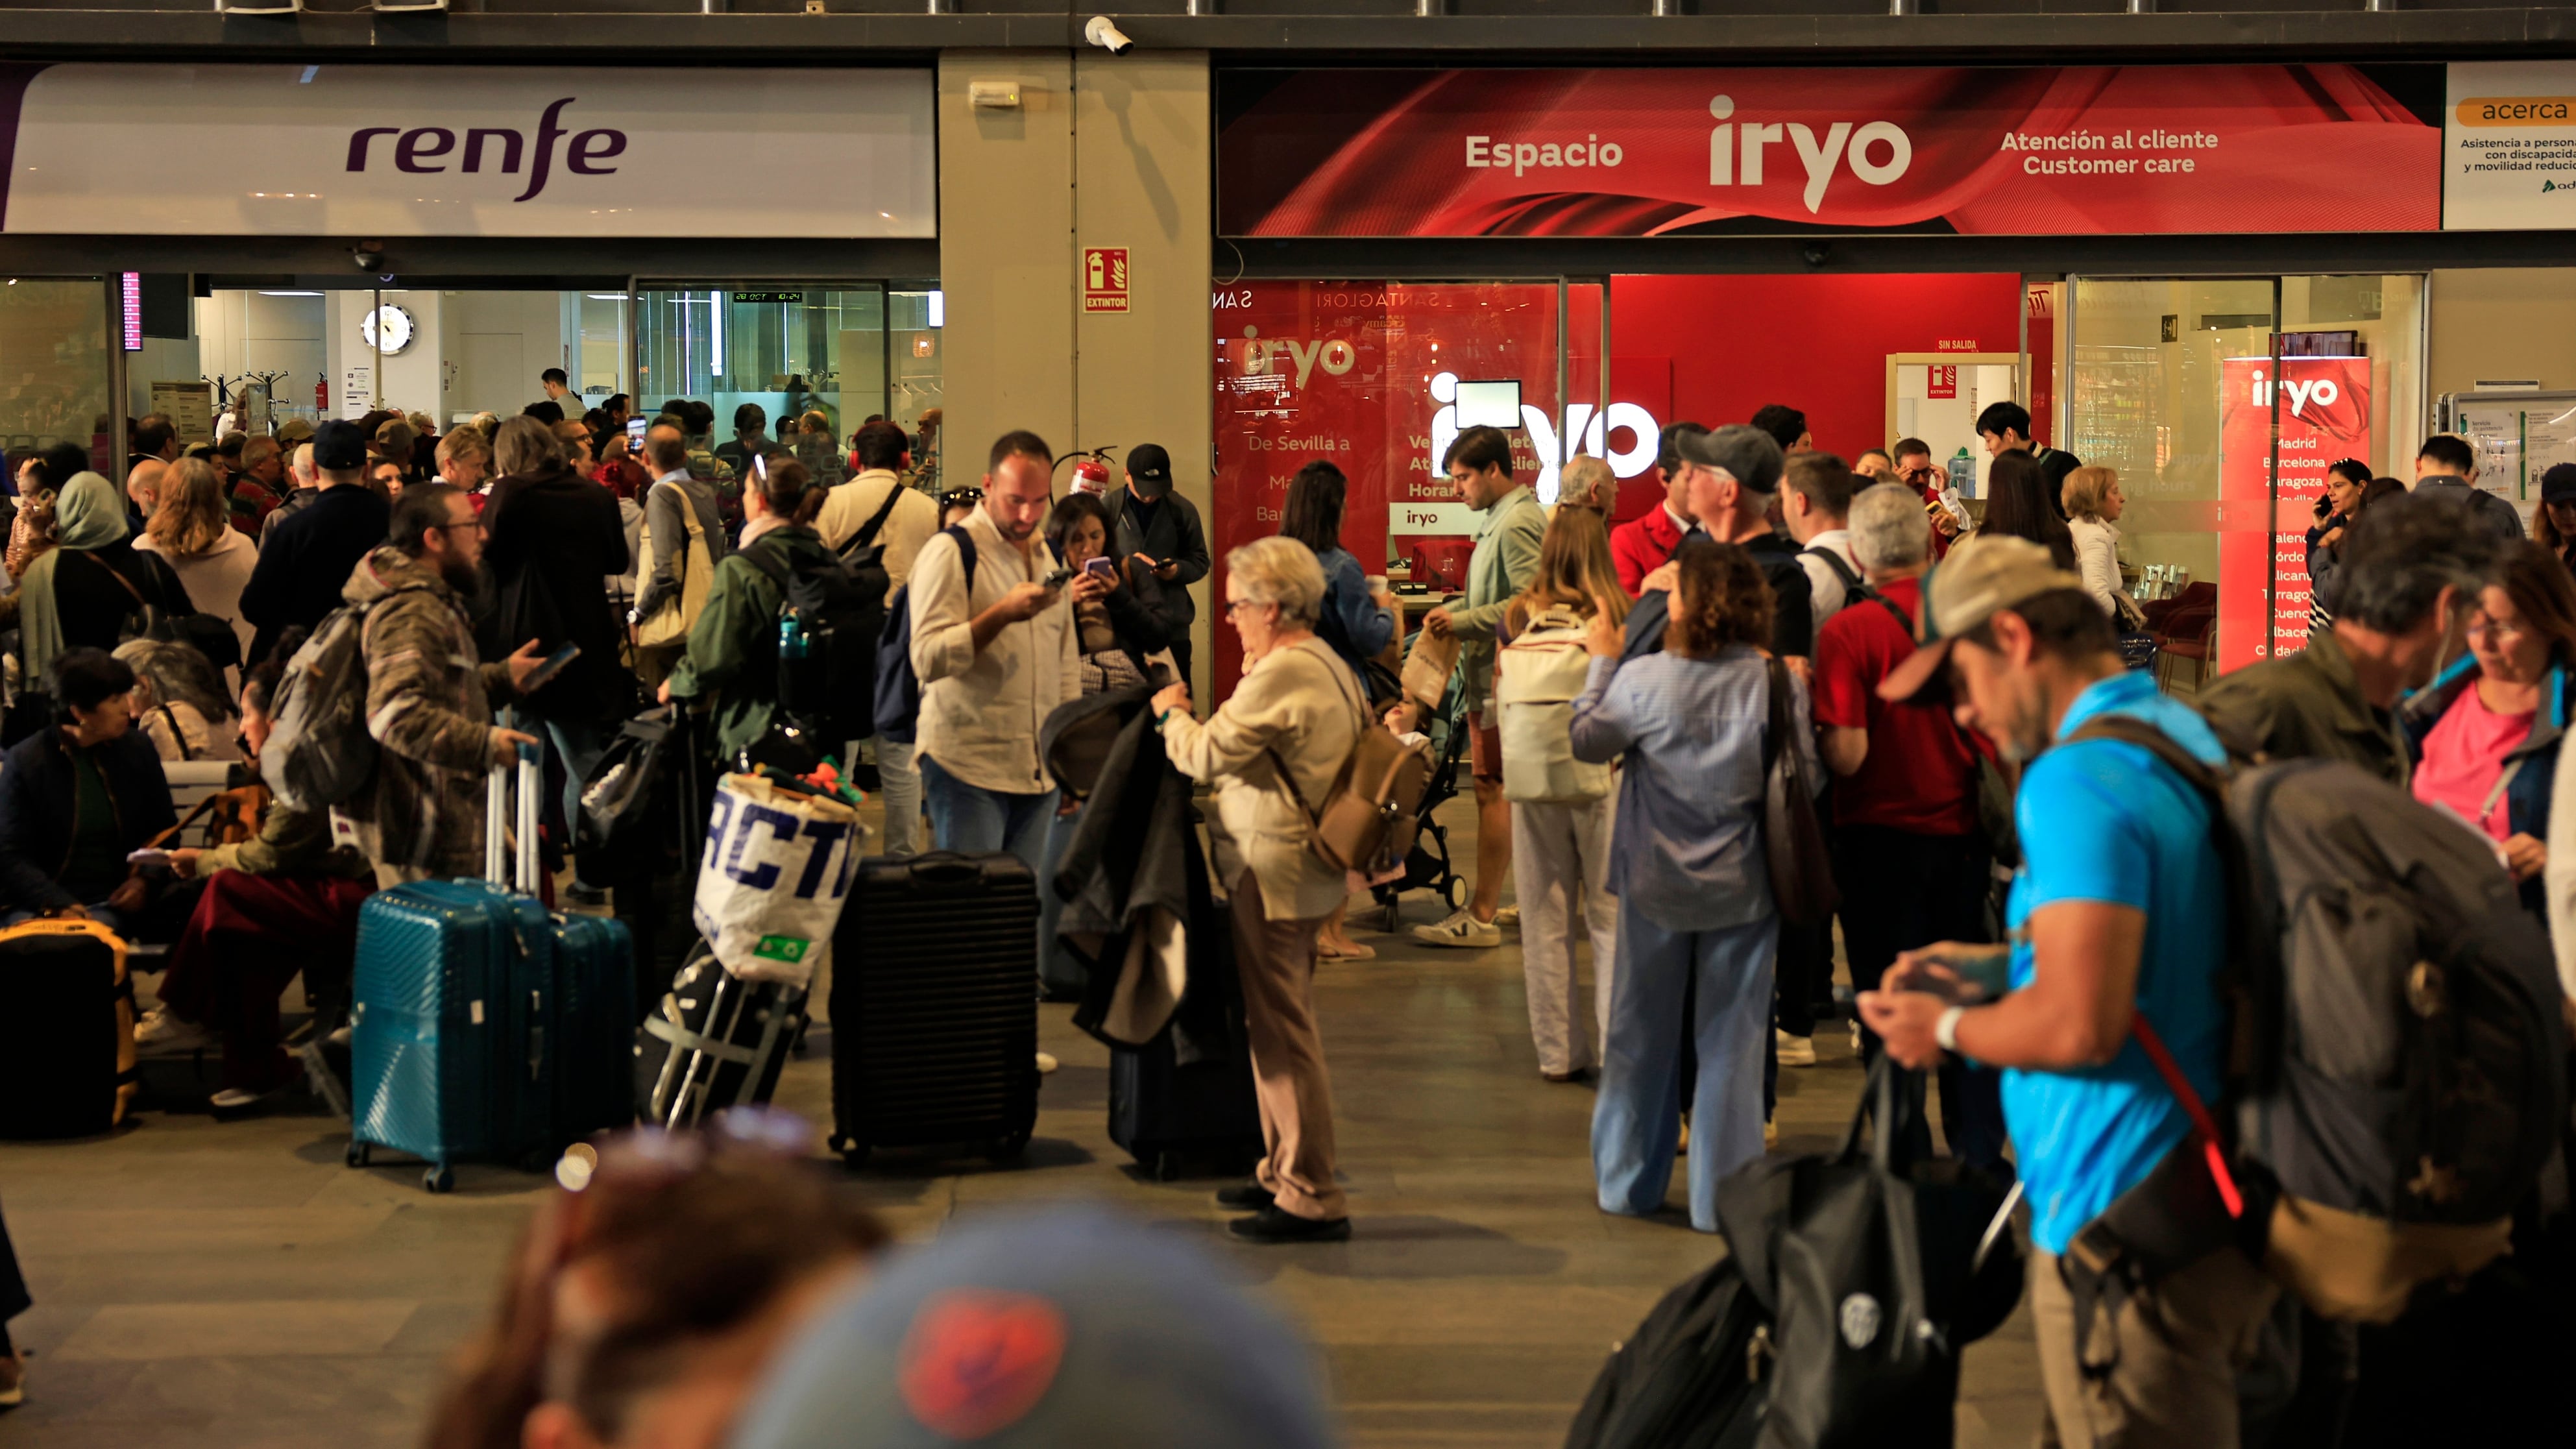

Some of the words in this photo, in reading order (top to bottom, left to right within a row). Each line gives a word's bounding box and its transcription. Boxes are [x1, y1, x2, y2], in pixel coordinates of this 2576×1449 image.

[2483, 103, 2568, 119] acerca
[346, 97, 627, 202] renfe
[2000, 130, 2105, 151] Atención
[2111, 130, 2133, 149] al
[2138, 130, 2218, 149] cliente
[2461, 138, 2521, 149] Asistencia
[2534, 139, 2576, 149] person
[1466, 134, 1623, 177] Espacio
[1710, 94, 1912, 214] iryo
[2485, 151, 2507, 160] con
[2023, 156, 2139, 175] Customer
[2144, 158, 2195, 173] care
[2464, 164, 2471, 173] y
[2474, 161, 2532, 171] movilidad
[1087, 297, 1126, 308] EXTINTOR
[1938, 340, 1950, 349] SIN
[1952, 340, 1976, 349] SALIDA
[1243, 324, 1355, 391] iryo
[2252, 370, 2339, 418] iryo
[1248, 436, 1272, 451] De
[1277, 435, 1335, 451] Sevilla
[1339, 439, 1350, 451] a
[1429, 371, 1660, 505] iyo
[2263, 457, 2326, 468] Brcelona
[1407, 510, 1438, 528] iryo
